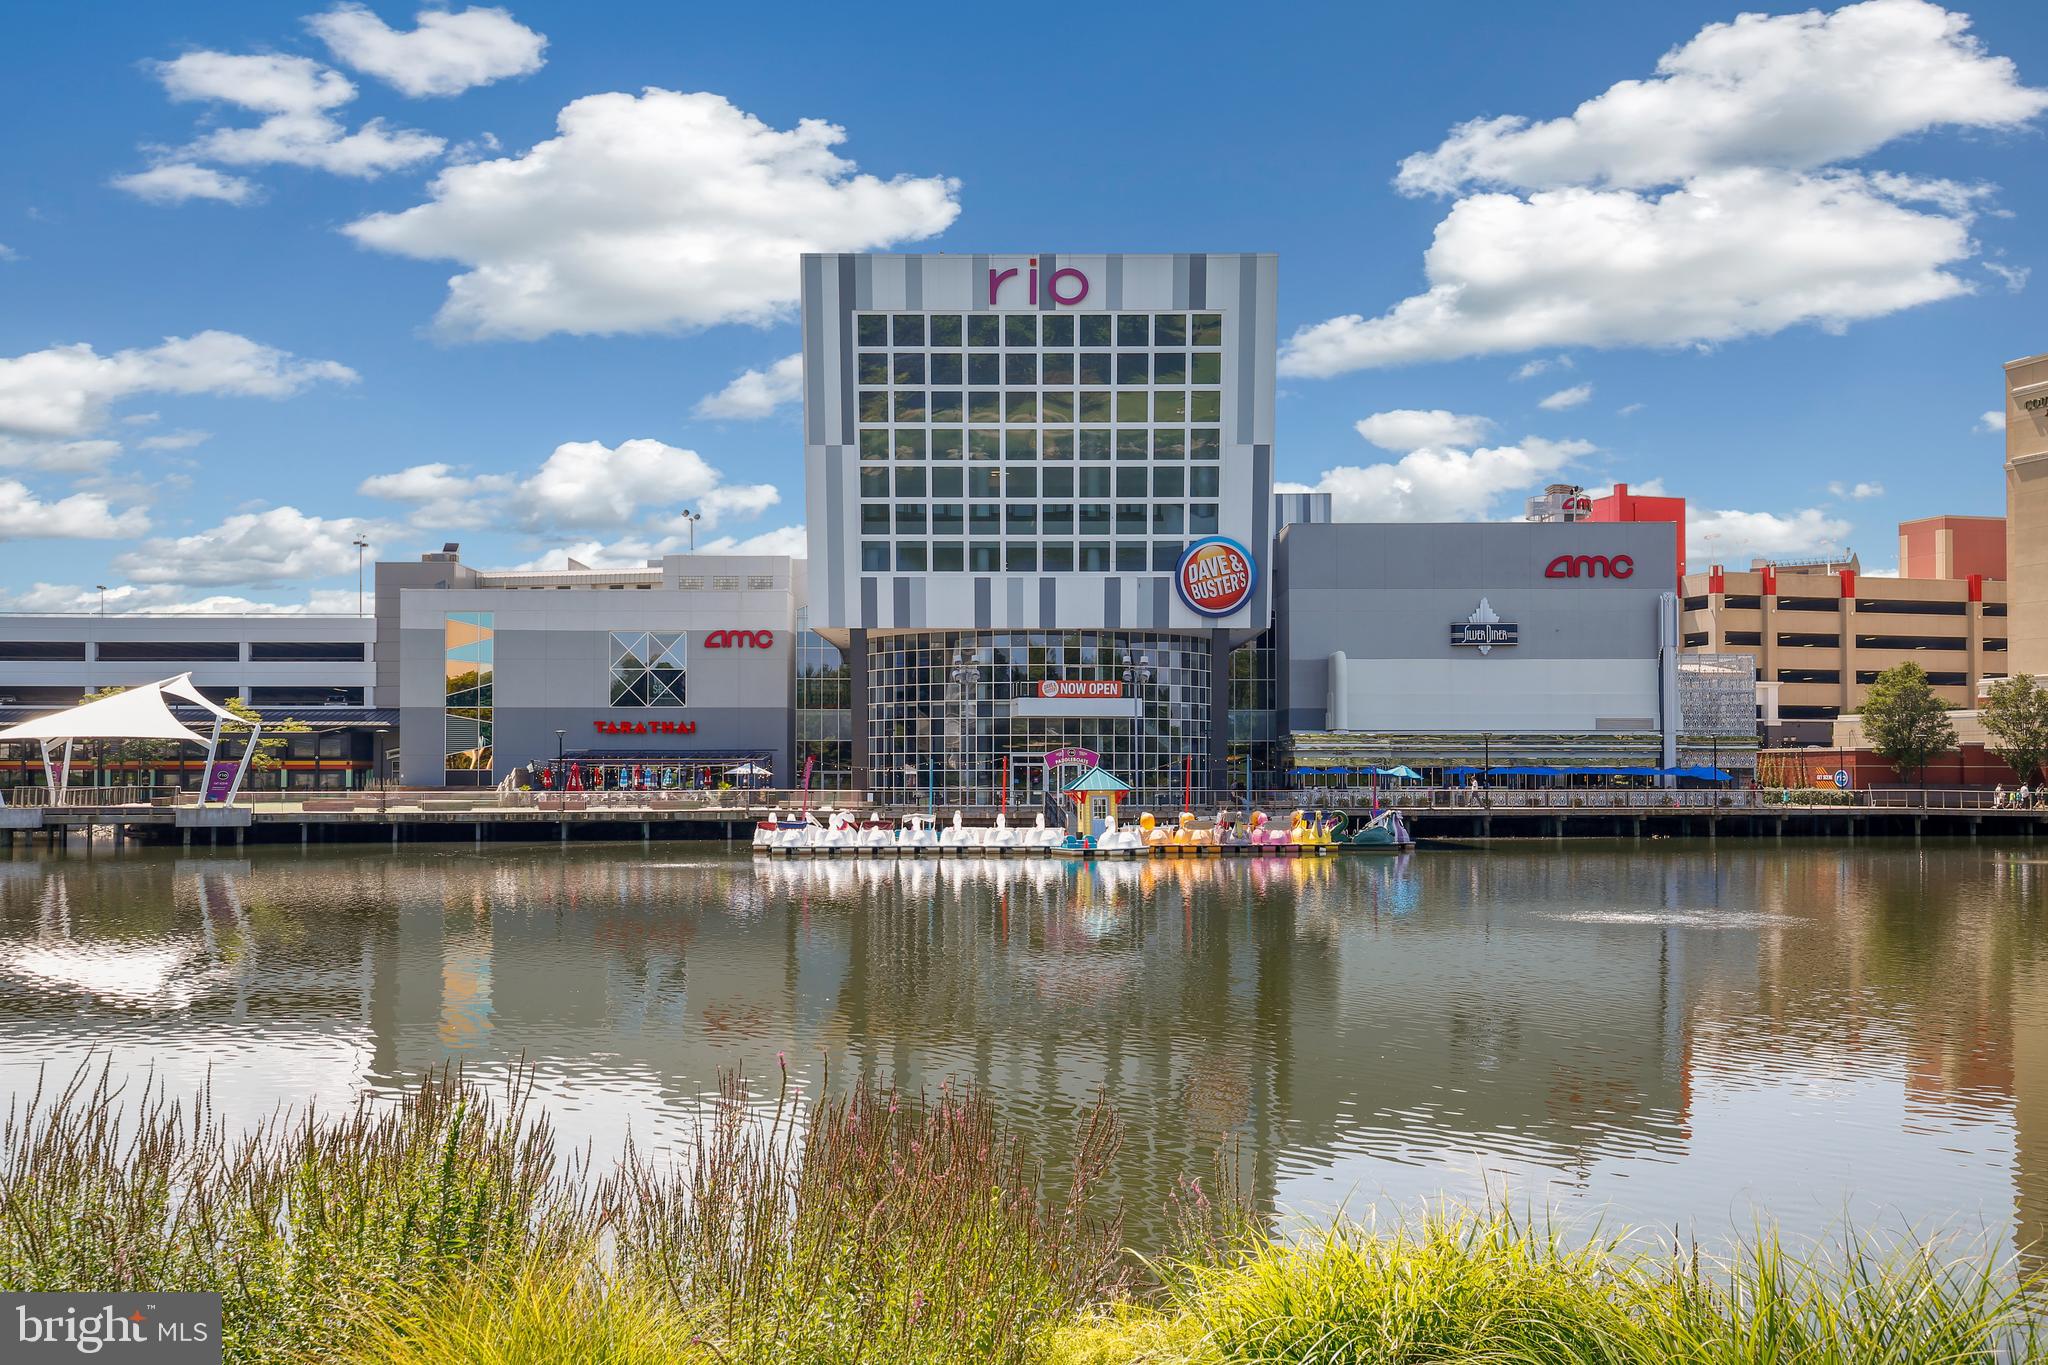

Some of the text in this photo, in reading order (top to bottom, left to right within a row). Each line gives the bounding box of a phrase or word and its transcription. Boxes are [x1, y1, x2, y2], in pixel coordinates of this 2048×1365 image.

[989, 258, 1089, 306] rio
[1188, 554, 1244, 584] DAVE &
[1190, 572, 1247, 600] BUSTER'S
[1462, 624, 1508, 643] SILVER DINER
[1060, 682, 1086, 695] NOW
[1089, 683, 1118, 695] OPEN
[593, 721, 695, 735] TARA THAI
